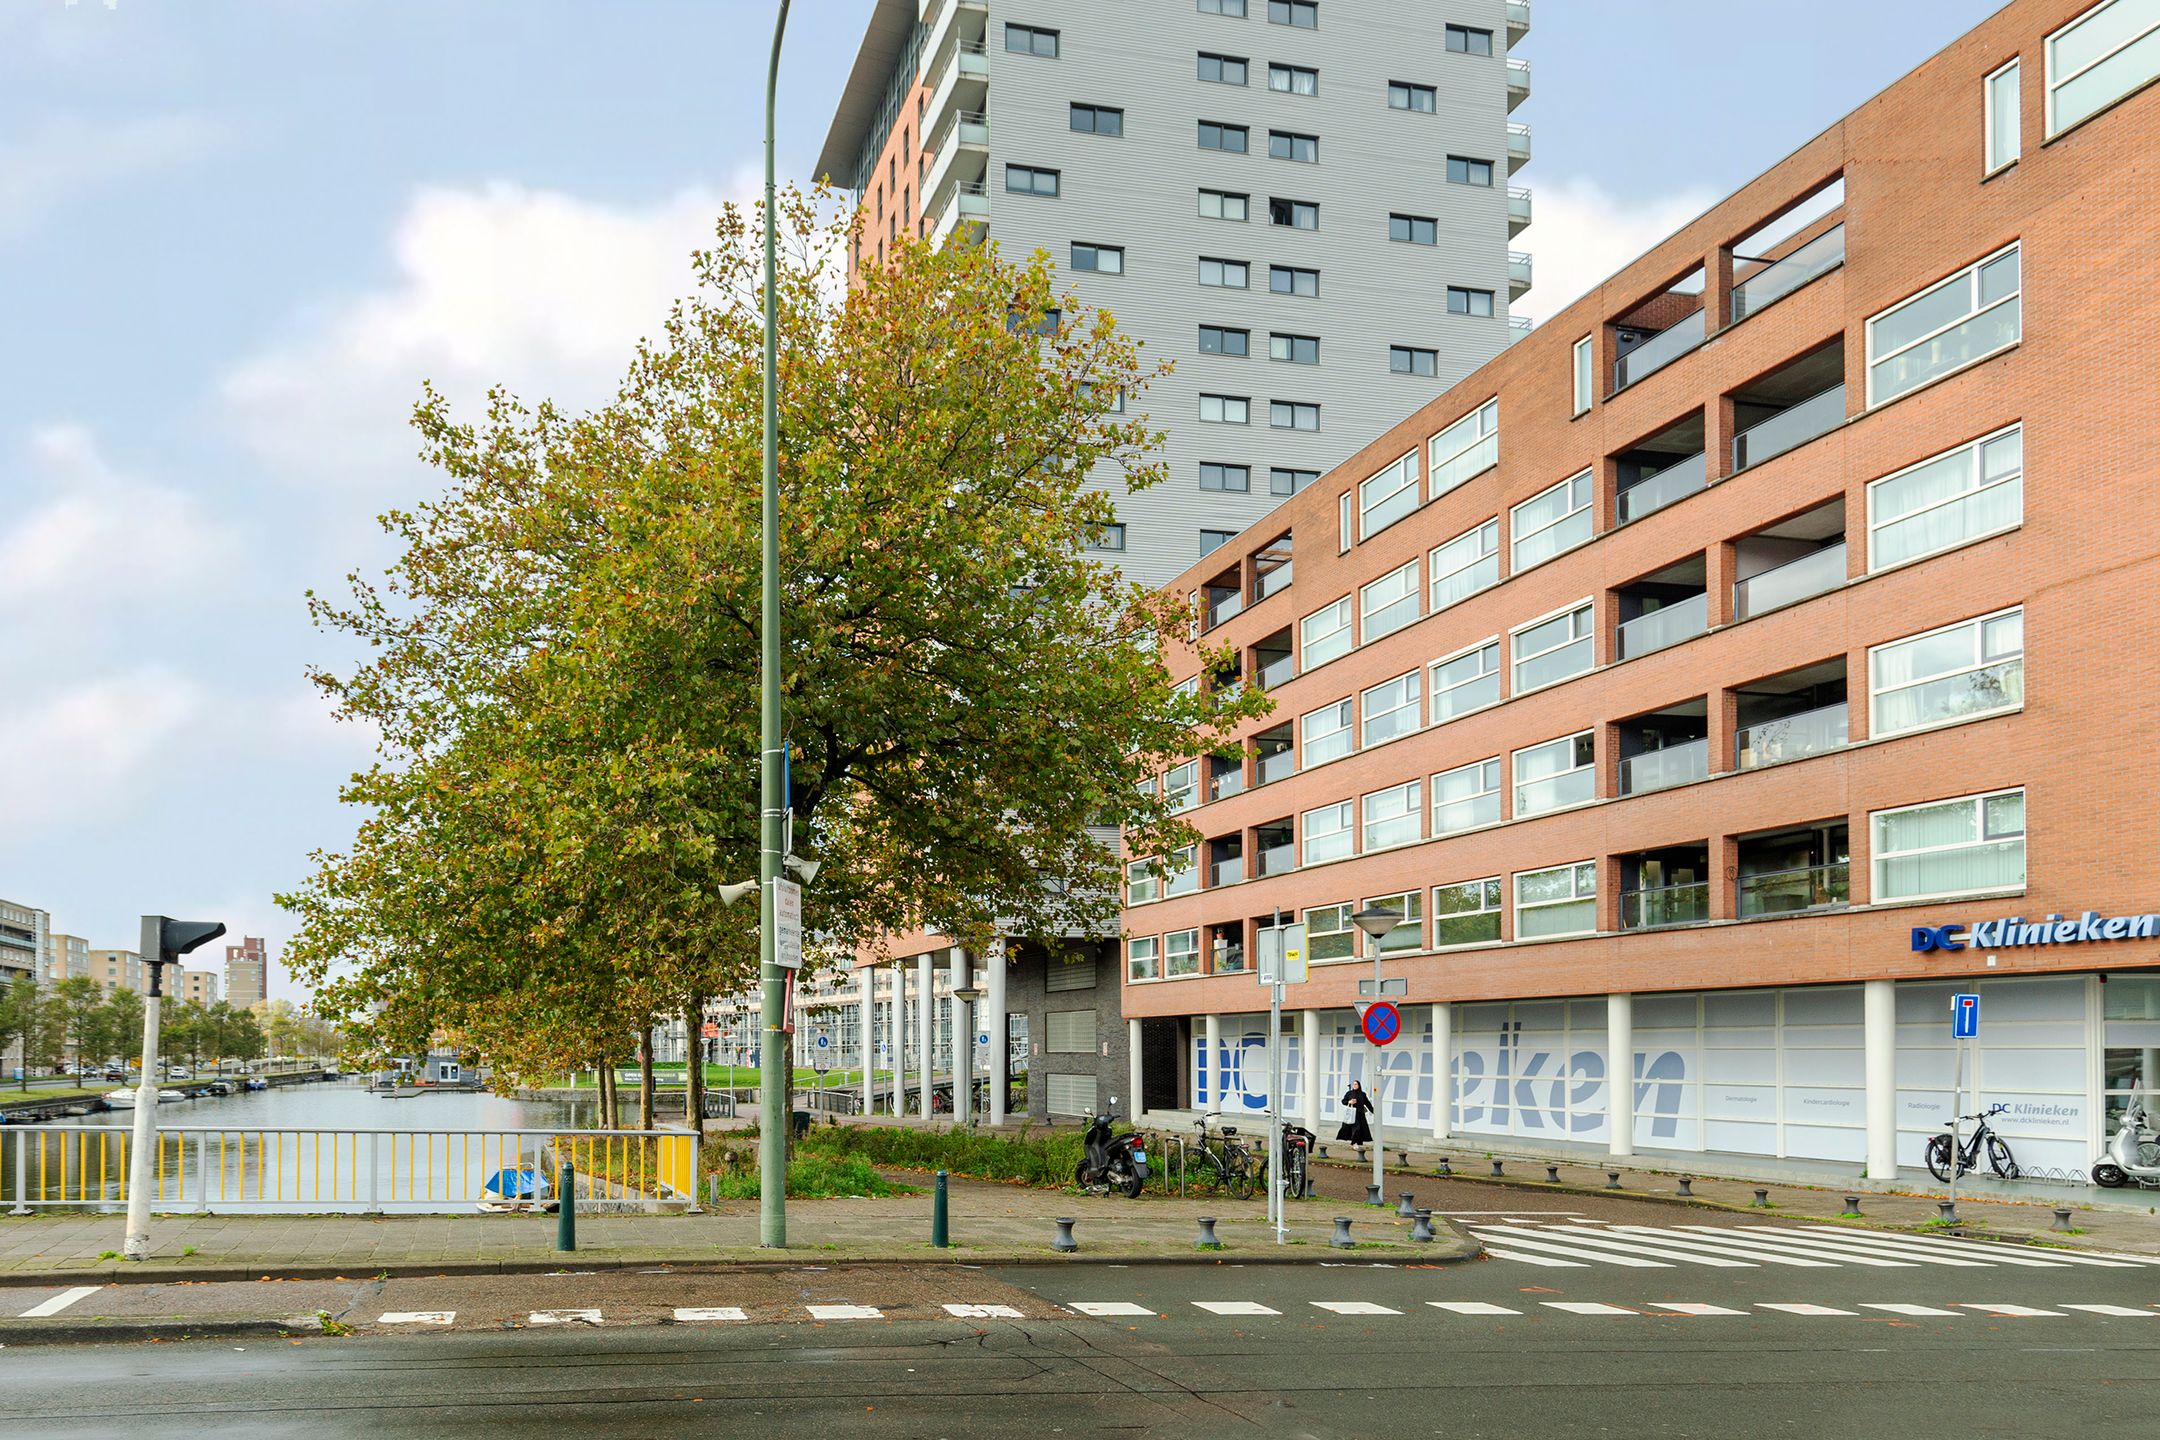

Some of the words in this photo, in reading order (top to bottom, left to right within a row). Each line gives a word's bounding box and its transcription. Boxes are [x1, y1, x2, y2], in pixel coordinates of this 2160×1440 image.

[1911, 924, 1966, 951] DC
[1969, 911, 2160, 949] Klinieken
[1197, 1031, 1268, 1109] DC
[1907, 1102, 1941, 1111] Radiologie
[1992, 1103, 2011, 1114] DC
[2014, 1103, 2079, 1116] Klinieken
[2001, 1117, 2070, 1126] www.dcklinieken.nl
